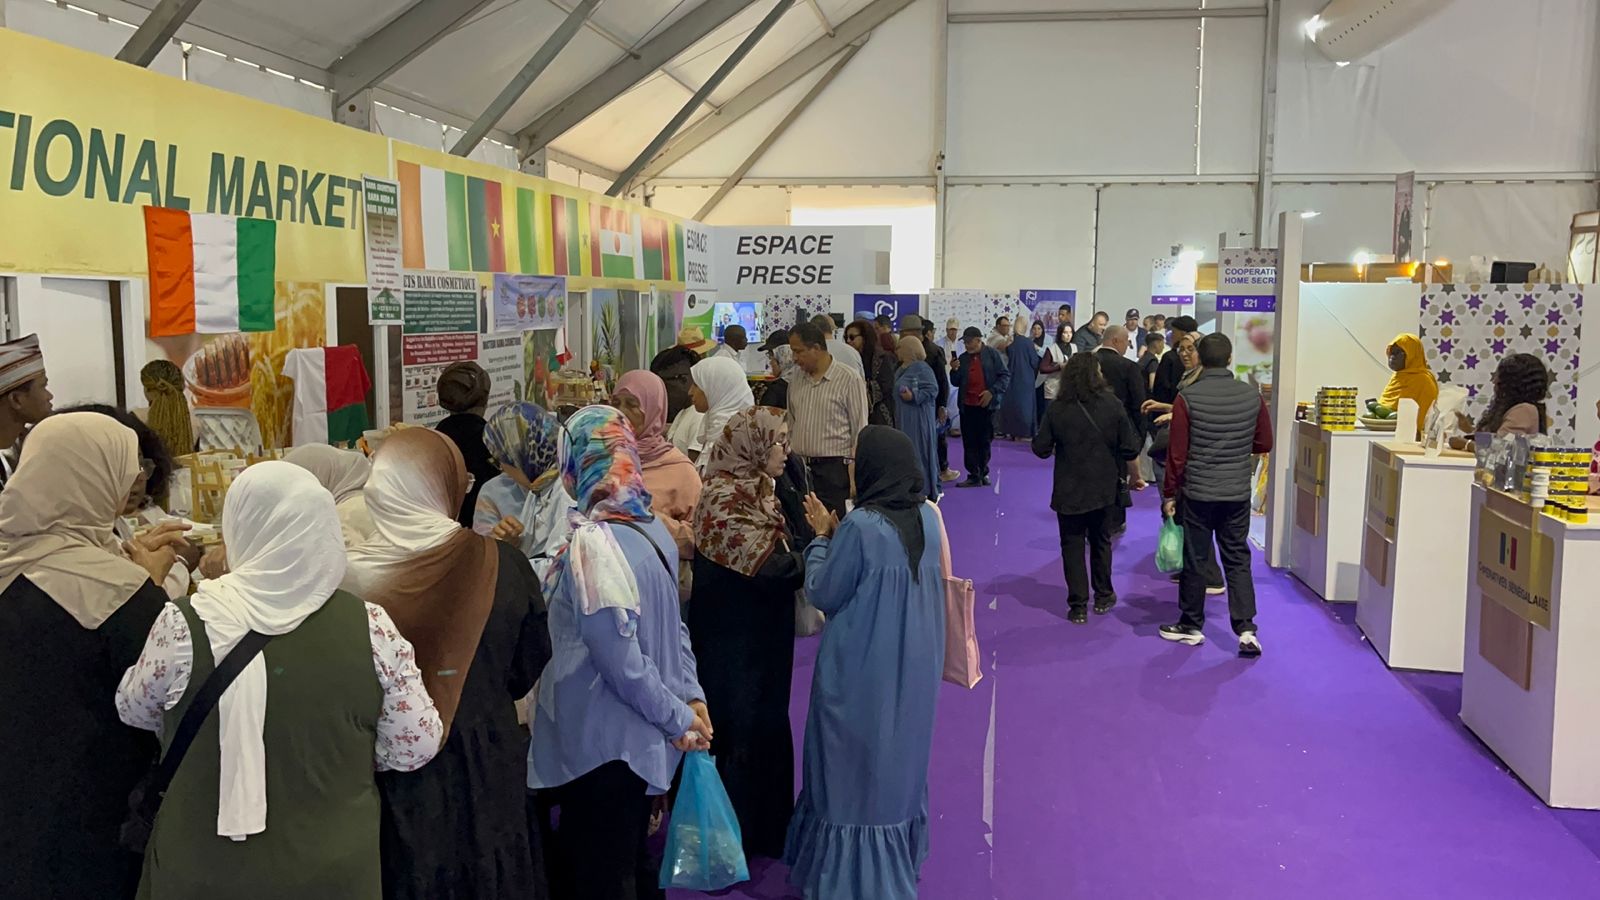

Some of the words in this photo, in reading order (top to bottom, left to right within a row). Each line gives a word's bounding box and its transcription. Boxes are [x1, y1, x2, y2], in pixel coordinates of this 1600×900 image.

[0, 111, 191, 211] IONAL
[207, 152, 362, 230] MARKET
[686, 229, 708, 254] ESPACE
[736, 235, 834, 255] ESPACE
[403, 274, 416, 288] ETS
[417, 275, 436, 289] RAMA
[437, 276, 476, 291] COSMETIQUE
[687, 261, 708, 284] PRESSE
[736, 265, 834, 285] PRESSE
[1225, 276, 1249, 285] HOME
[1243, 298, 1258, 308] 521
